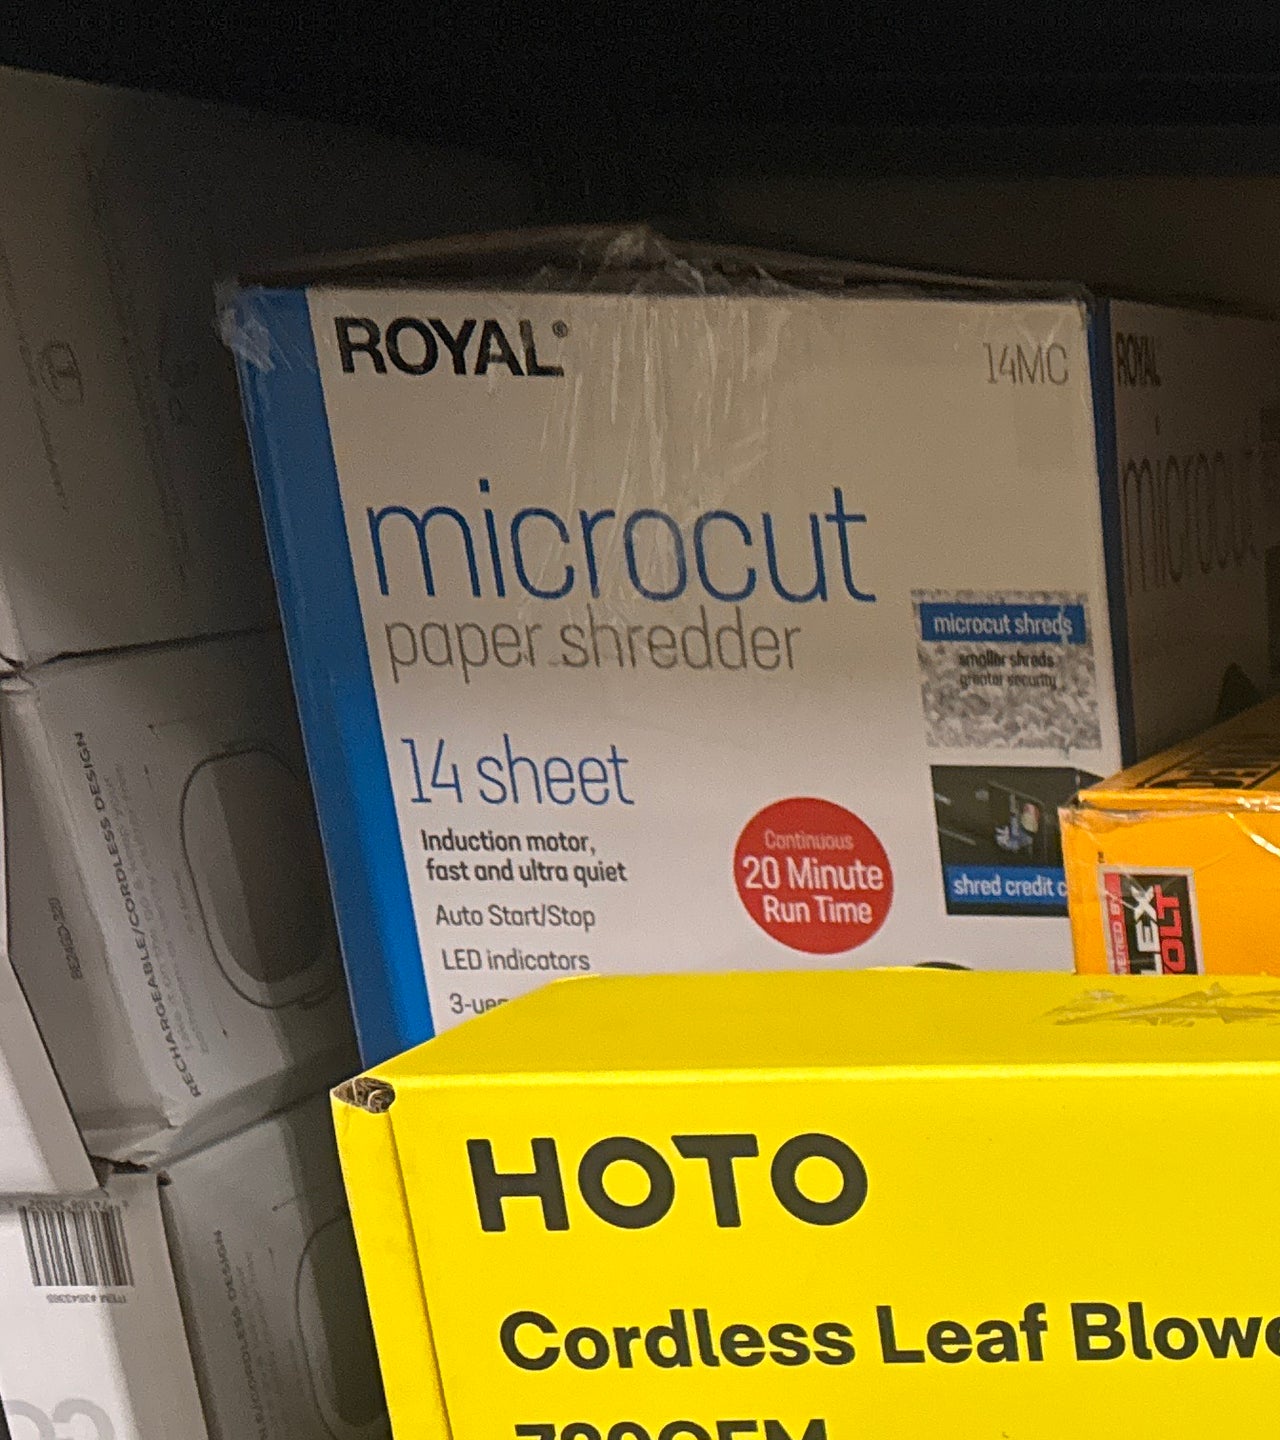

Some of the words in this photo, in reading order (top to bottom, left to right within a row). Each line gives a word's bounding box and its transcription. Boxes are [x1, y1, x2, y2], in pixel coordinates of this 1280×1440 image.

[982, 342, 1070, 386] 14MC
[366, 477, 876, 604] microcut
[385, 621, 543, 685] paper
[559, 602, 802, 672] shredder
[933, 611, 1012, 634] microcut
[1014, 612, 1073, 636] shreds
[74, 730, 106, 812] DESIGN
[400, 737, 462, 804] 14
[476, 733, 635, 807] sheet
[420, 829, 522, 853] Induction
[525, 831, 597, 857] motor,
[764, 829, 854, 852] Continuous
[425, 858, 471, 883] fast
[474, 859, 515, 882] and
[518, 858, 569, 882] ultra
[573, 861, 628, 889] quiet
[742, 855, 780, 890] 20
[787, 856, 884, 891] Minute
[953, 876, 1002, 897] shred
[1005, 876, 1054, 897] credit
[435, 904, 484, 928] Auto
[489, 903, 597, 933] Start/Stop
[762, 897, 811, 924] Run
[814, 897, 873, 925] Time
[1131, 885, 1162, 975] LEX
[1155, 884, 1187, 975] OLT
[441, 948, 482, 972] LED
[486, 948, 591, 972] indicators
[464, 1130, 870, 1234] HOTO
[498, 1308, 857, 1372] Cordless
[874, 1300, 1049, 1366] Leaf
